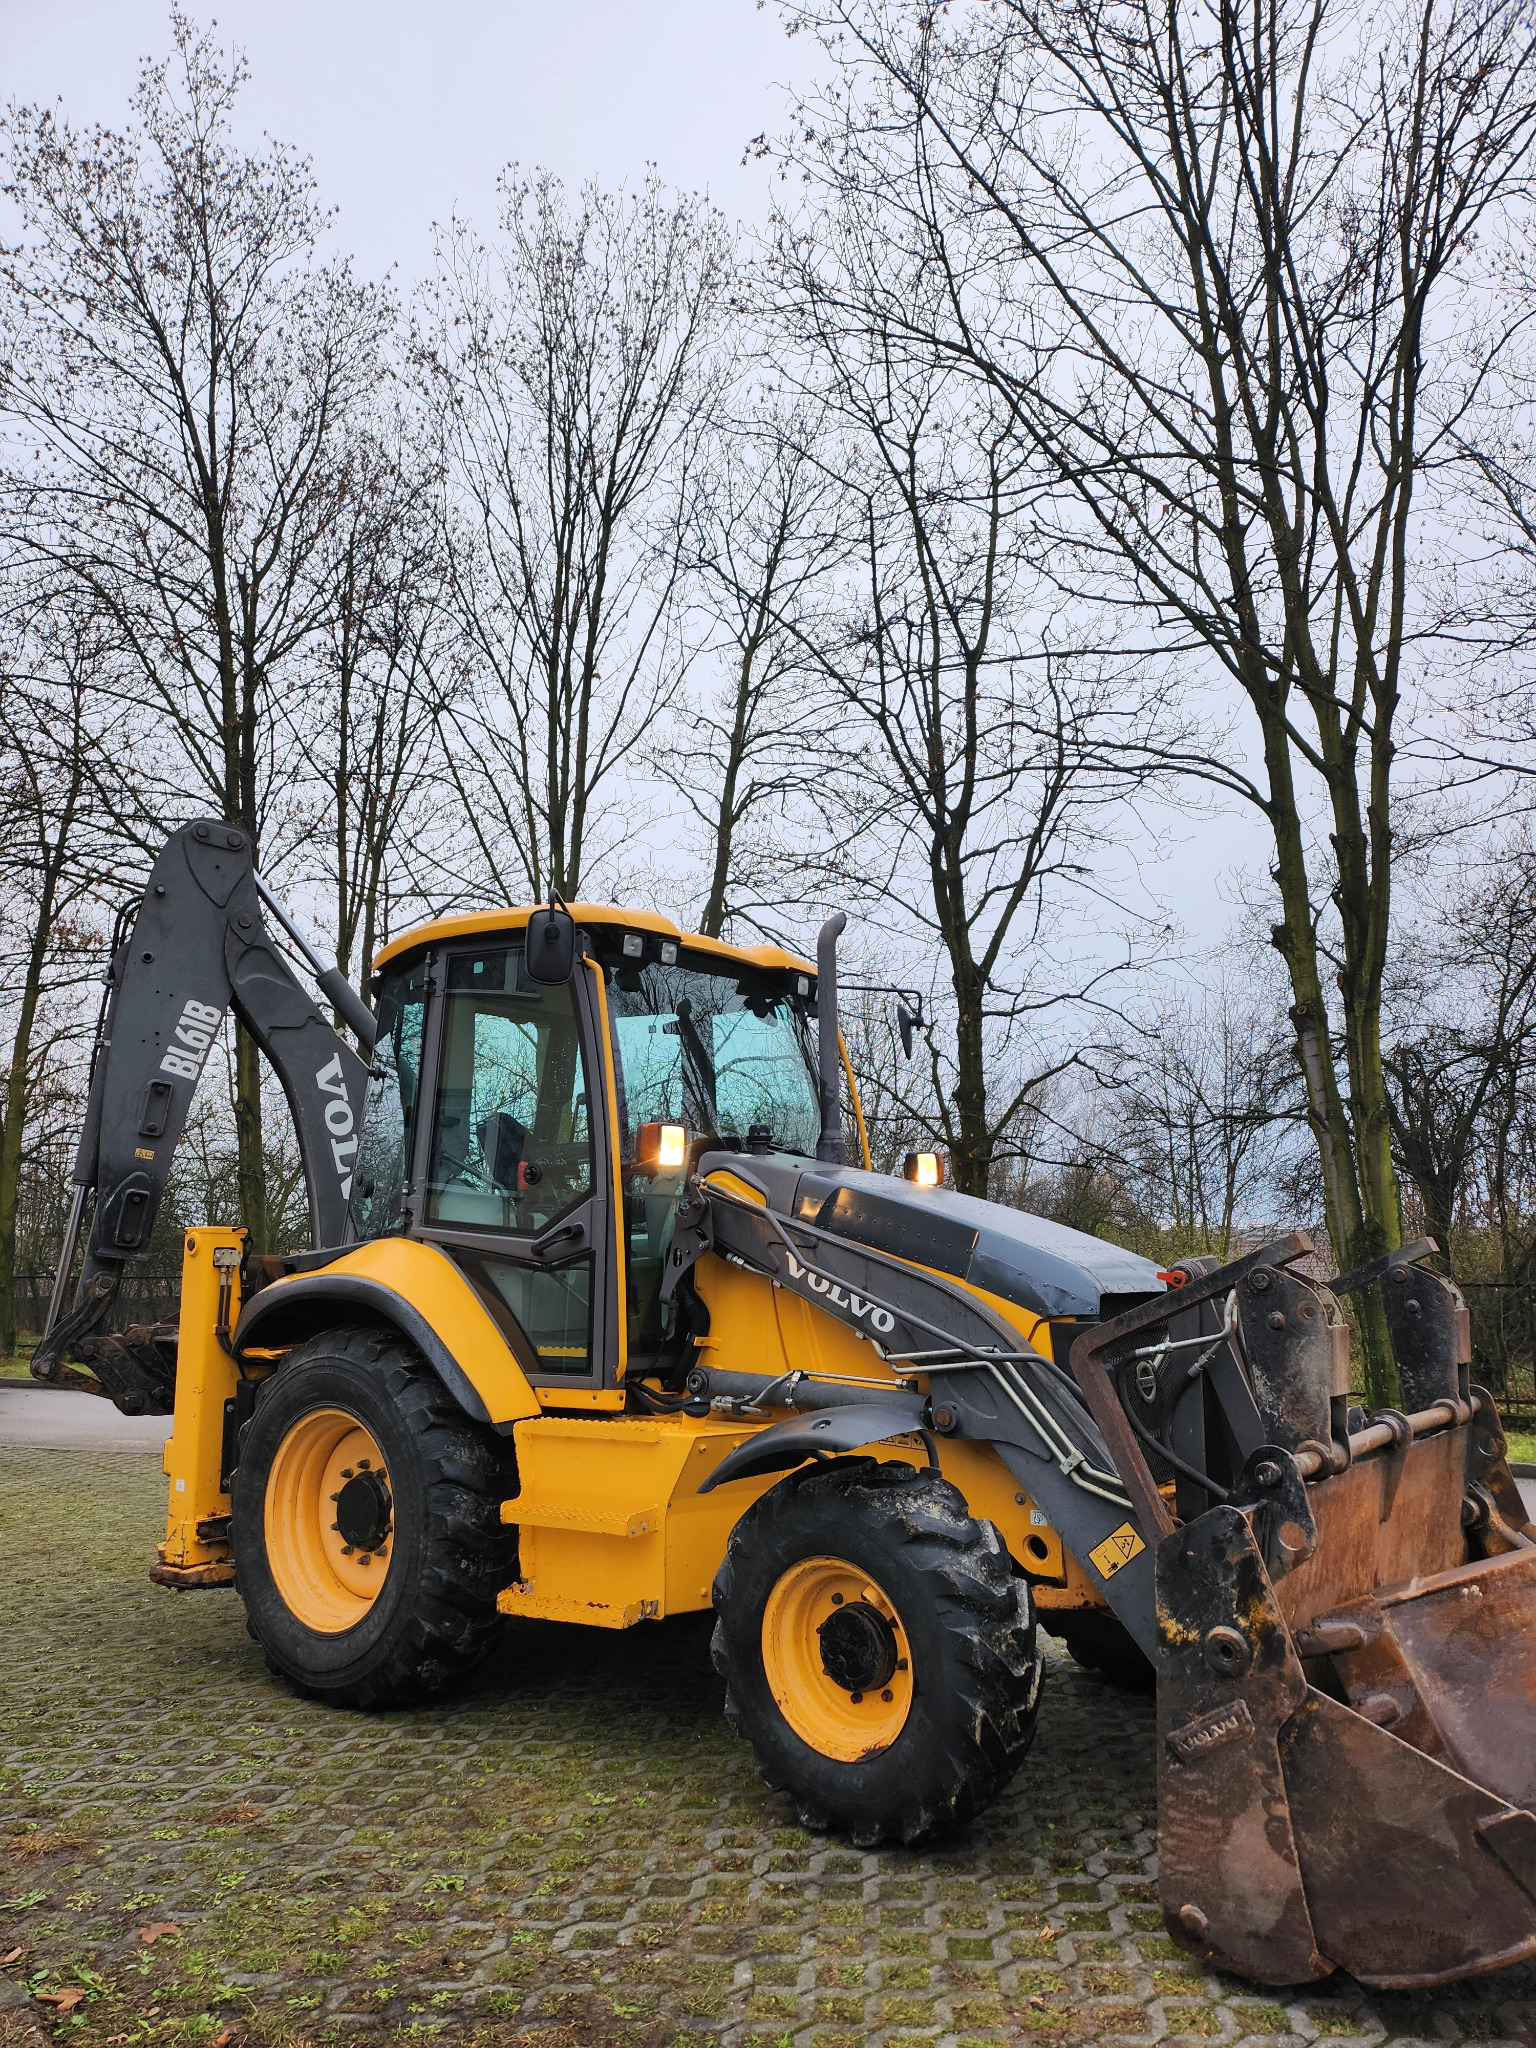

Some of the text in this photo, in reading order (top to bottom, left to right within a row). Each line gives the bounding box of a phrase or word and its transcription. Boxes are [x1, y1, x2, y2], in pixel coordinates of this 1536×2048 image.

[160, 1000, 222, 1080] BL61B
[315, 1052, 359, 1200] VOL
[785, 1250, 895, 1333] VOLVO
